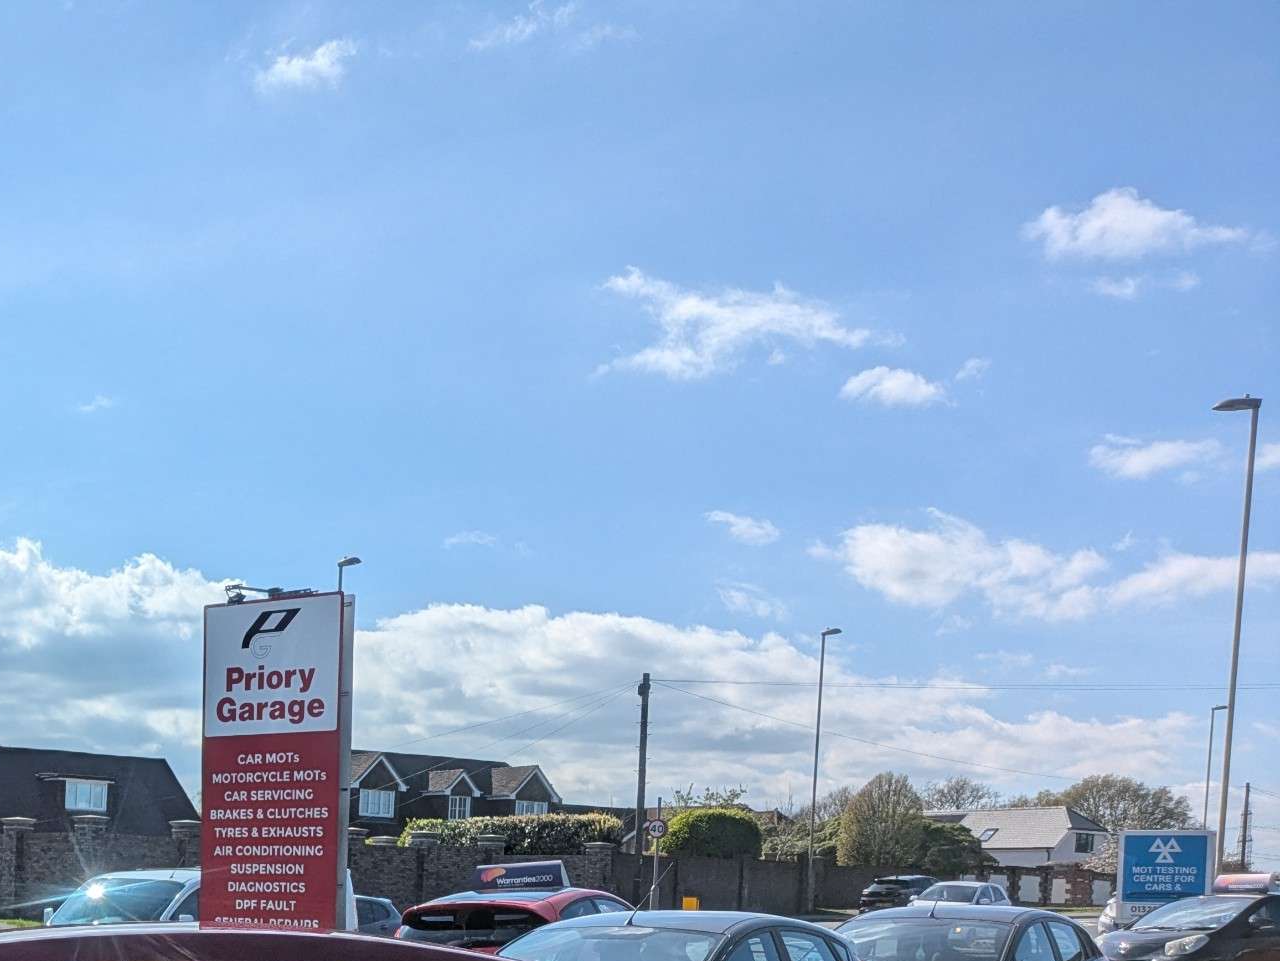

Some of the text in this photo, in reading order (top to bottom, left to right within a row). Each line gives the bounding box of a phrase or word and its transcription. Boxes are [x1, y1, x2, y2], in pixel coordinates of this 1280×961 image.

[225, 664, 316, 693] Priory
[216, 697, 325, 724] Garage
[237, 752, 300, 765] CAR MOTs
[212, 770, 327, 784] MOTORCYCLE MOTs
[224, 789, 314, 801] CAR SERVICING
[210, 807, 329, 820] BRAKES & CLUTCHES
[214, 826, 324, 838] TYRES & EXHAUSTS
[650, 824, 664, 834] 40
[214, 845, 324, 857] AIR CONDITIONING
[230, 863, 305, 875] SUSPENSION
[1132, 866, 1197, 875] MOT TESTING
[1174, 875, 1195, 883] FOR
[227, 881, 306, 893] DIAGNOSTICS
[1144, 883, 1182, 891] CARS &
[235, 900, 296, 911] DPF FAULT
